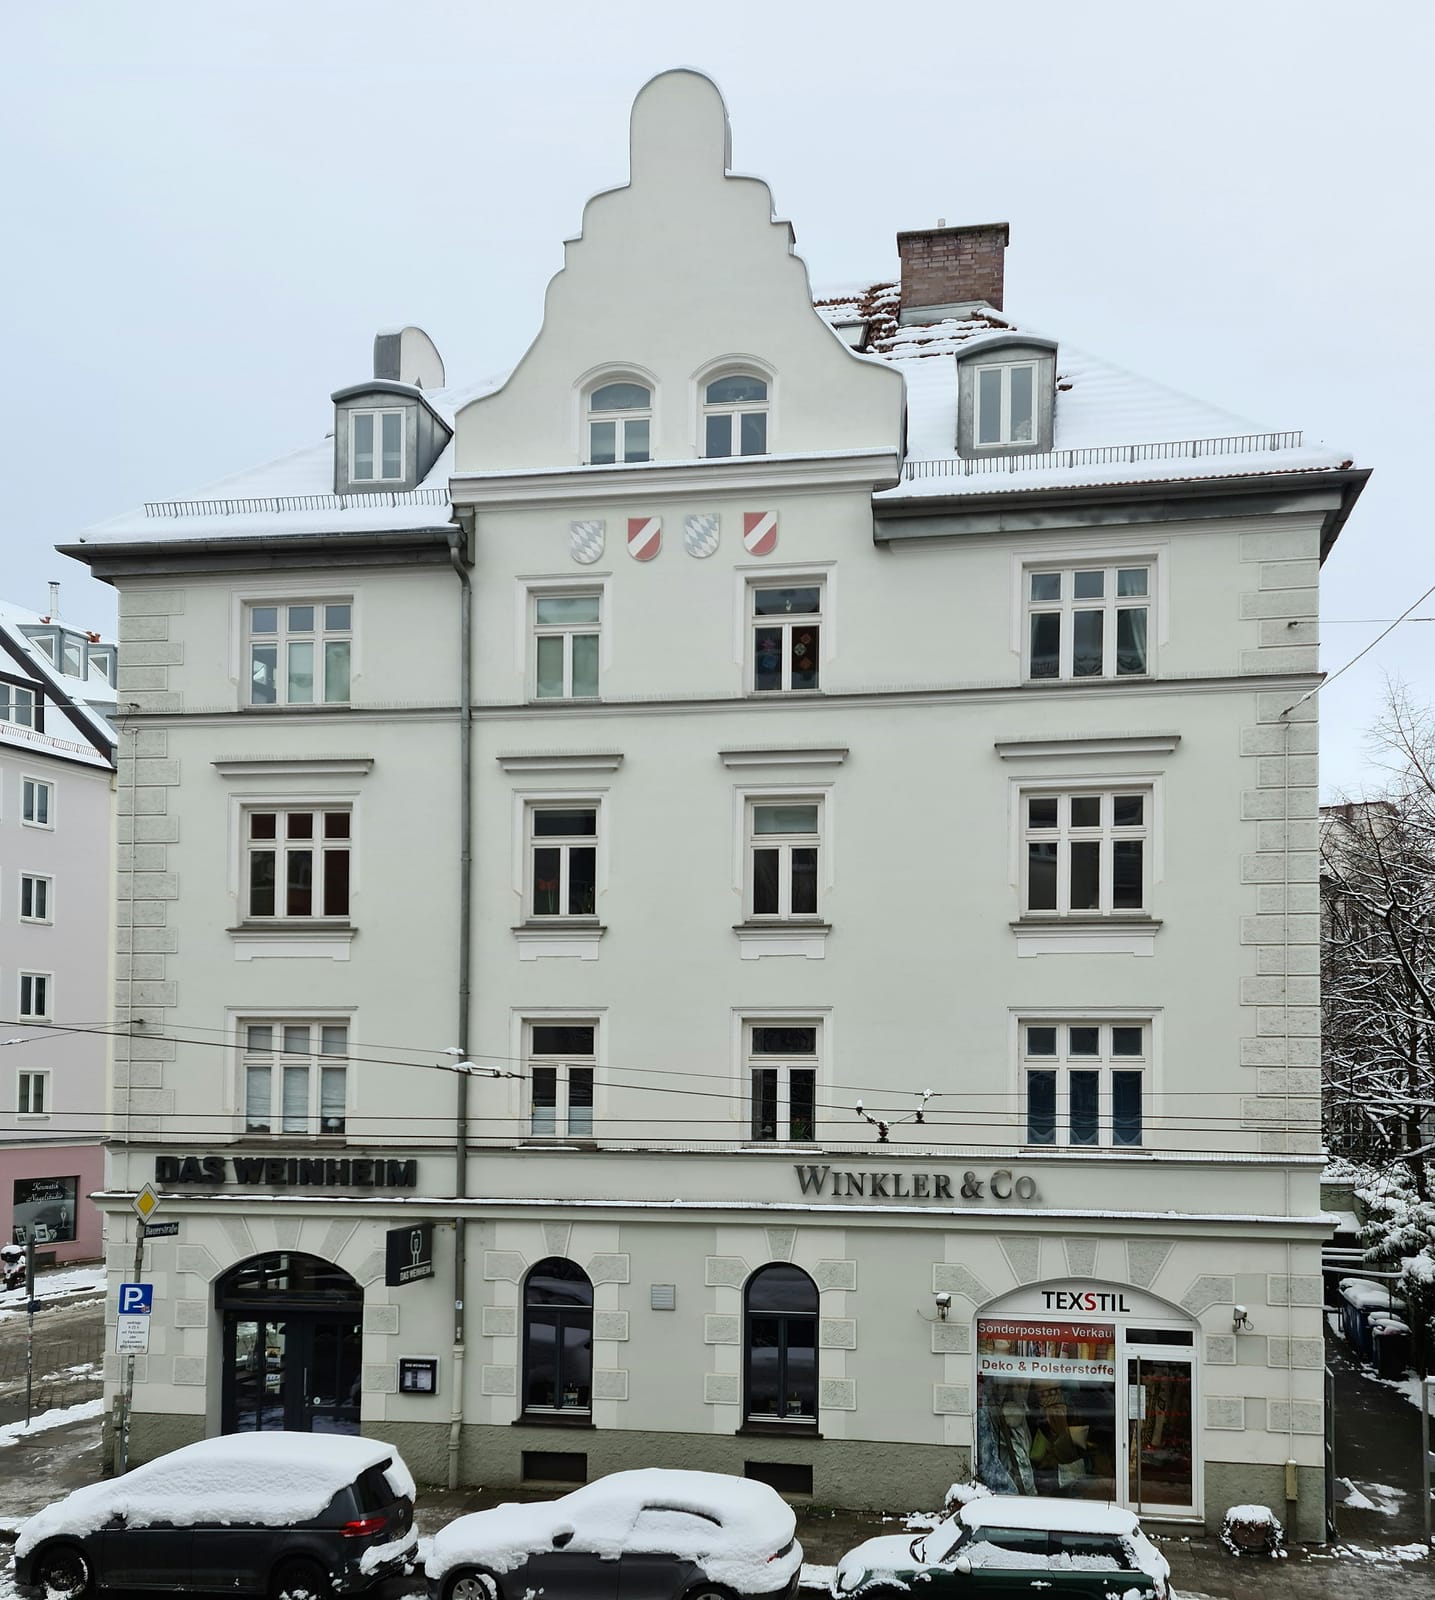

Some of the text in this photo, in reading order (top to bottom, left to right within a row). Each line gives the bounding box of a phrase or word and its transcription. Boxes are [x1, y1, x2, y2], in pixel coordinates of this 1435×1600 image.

[155, 1156, 417, 1187] DAS WEINHEIM
[123, 1287, 143, 1311] P
[1041, 1290, 1130, 1312] TEXSTIL
[978, 1323, 1060, 1337] Sonderposten
[1071, 1326, 1115, 1338] Verkau
[982, 1359, 1114, 1376] Deko & Polsterstoffe
